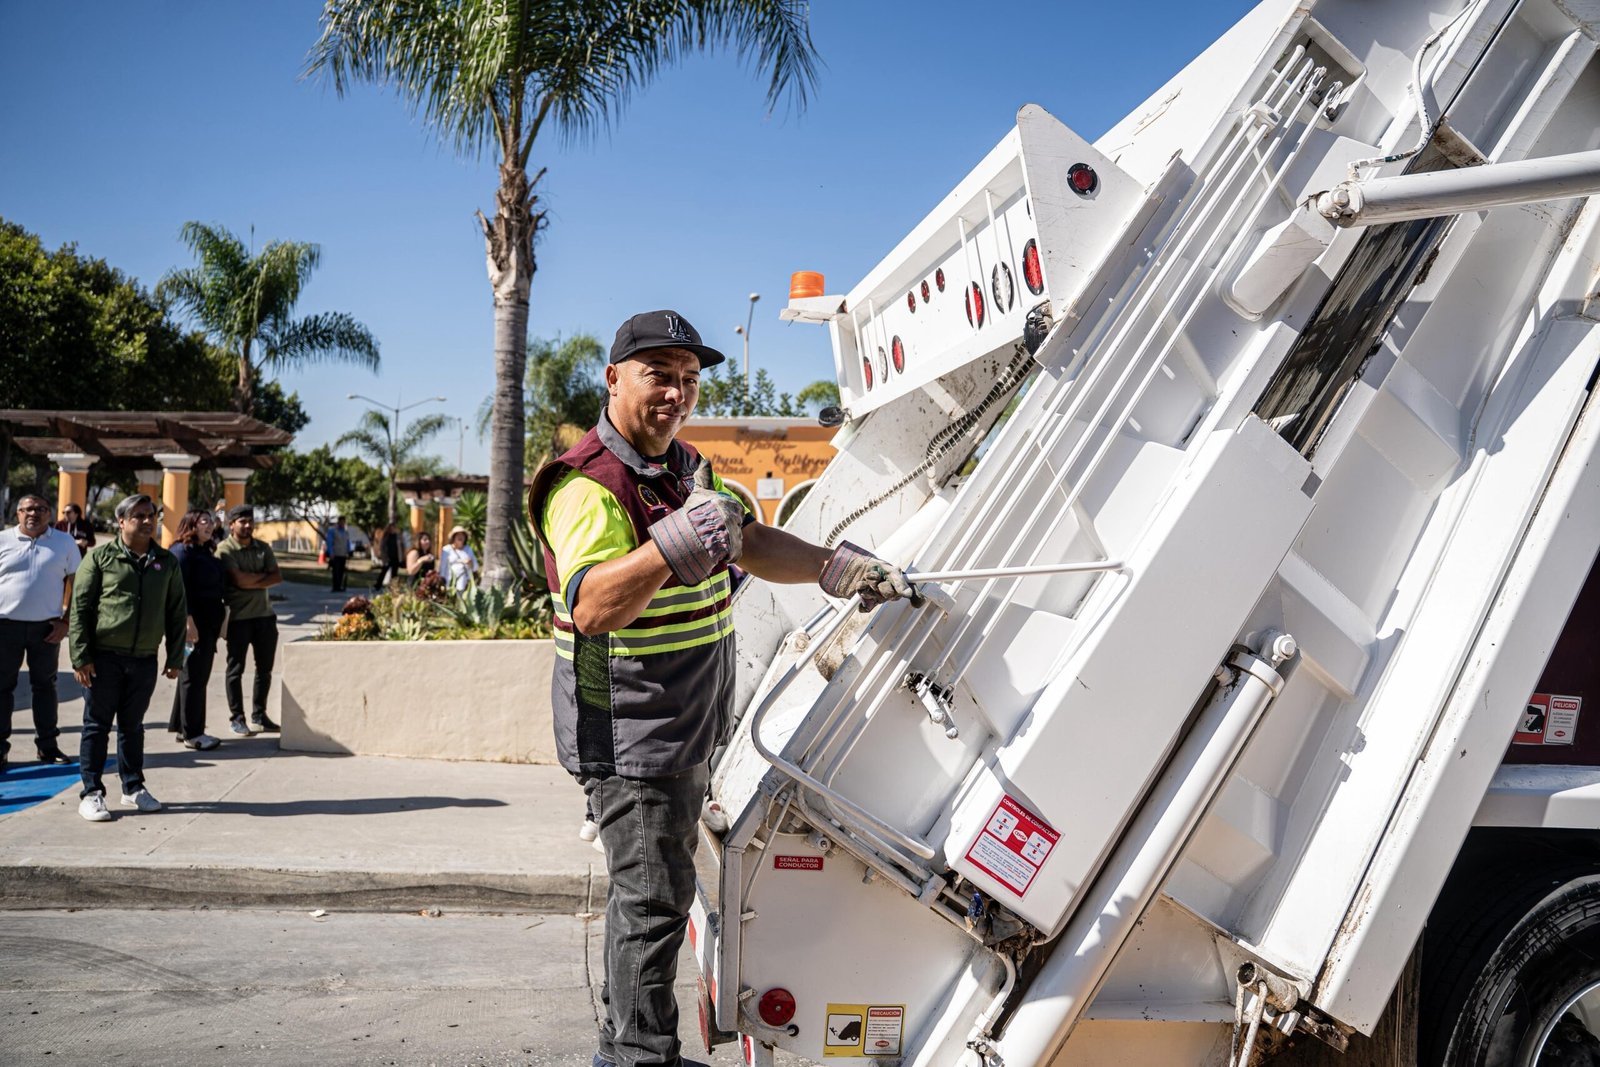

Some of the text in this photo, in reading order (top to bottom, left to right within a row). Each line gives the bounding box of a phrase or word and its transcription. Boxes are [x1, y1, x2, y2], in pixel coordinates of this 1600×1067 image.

[665, 314, 691, 342] LA
[1002, 798, 1026, 817] CONTROLES
[1030, 818, 1058, 840] COMPACTADO
